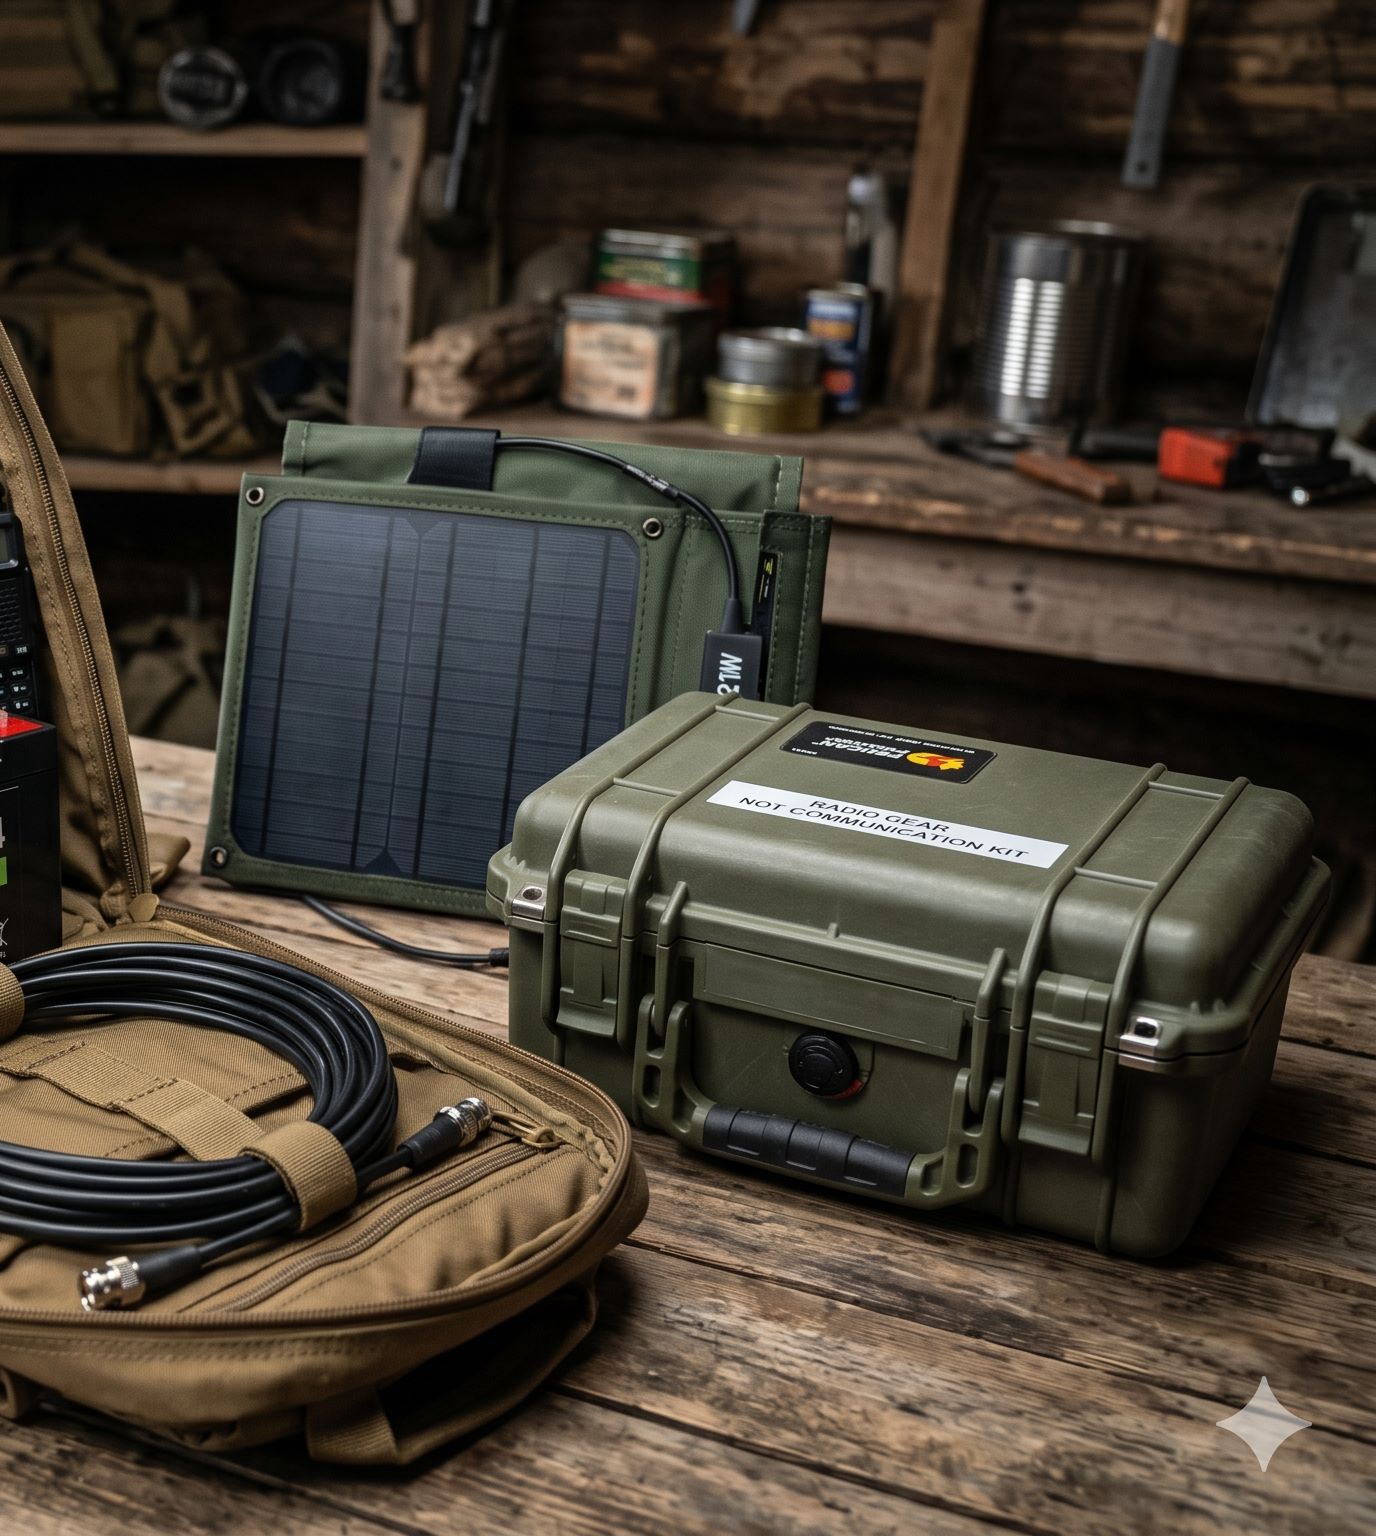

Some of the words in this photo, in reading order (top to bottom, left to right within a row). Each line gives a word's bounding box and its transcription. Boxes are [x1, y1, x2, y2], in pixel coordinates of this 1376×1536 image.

[739, 797, 787, 811] NOT
[789, 807, 984, 850] COMMUNICATION
[988, 845, 1030, 858] KIT
[809, 800, 880, 819] RADIO
[885, 815, 950, 833] GEAR
